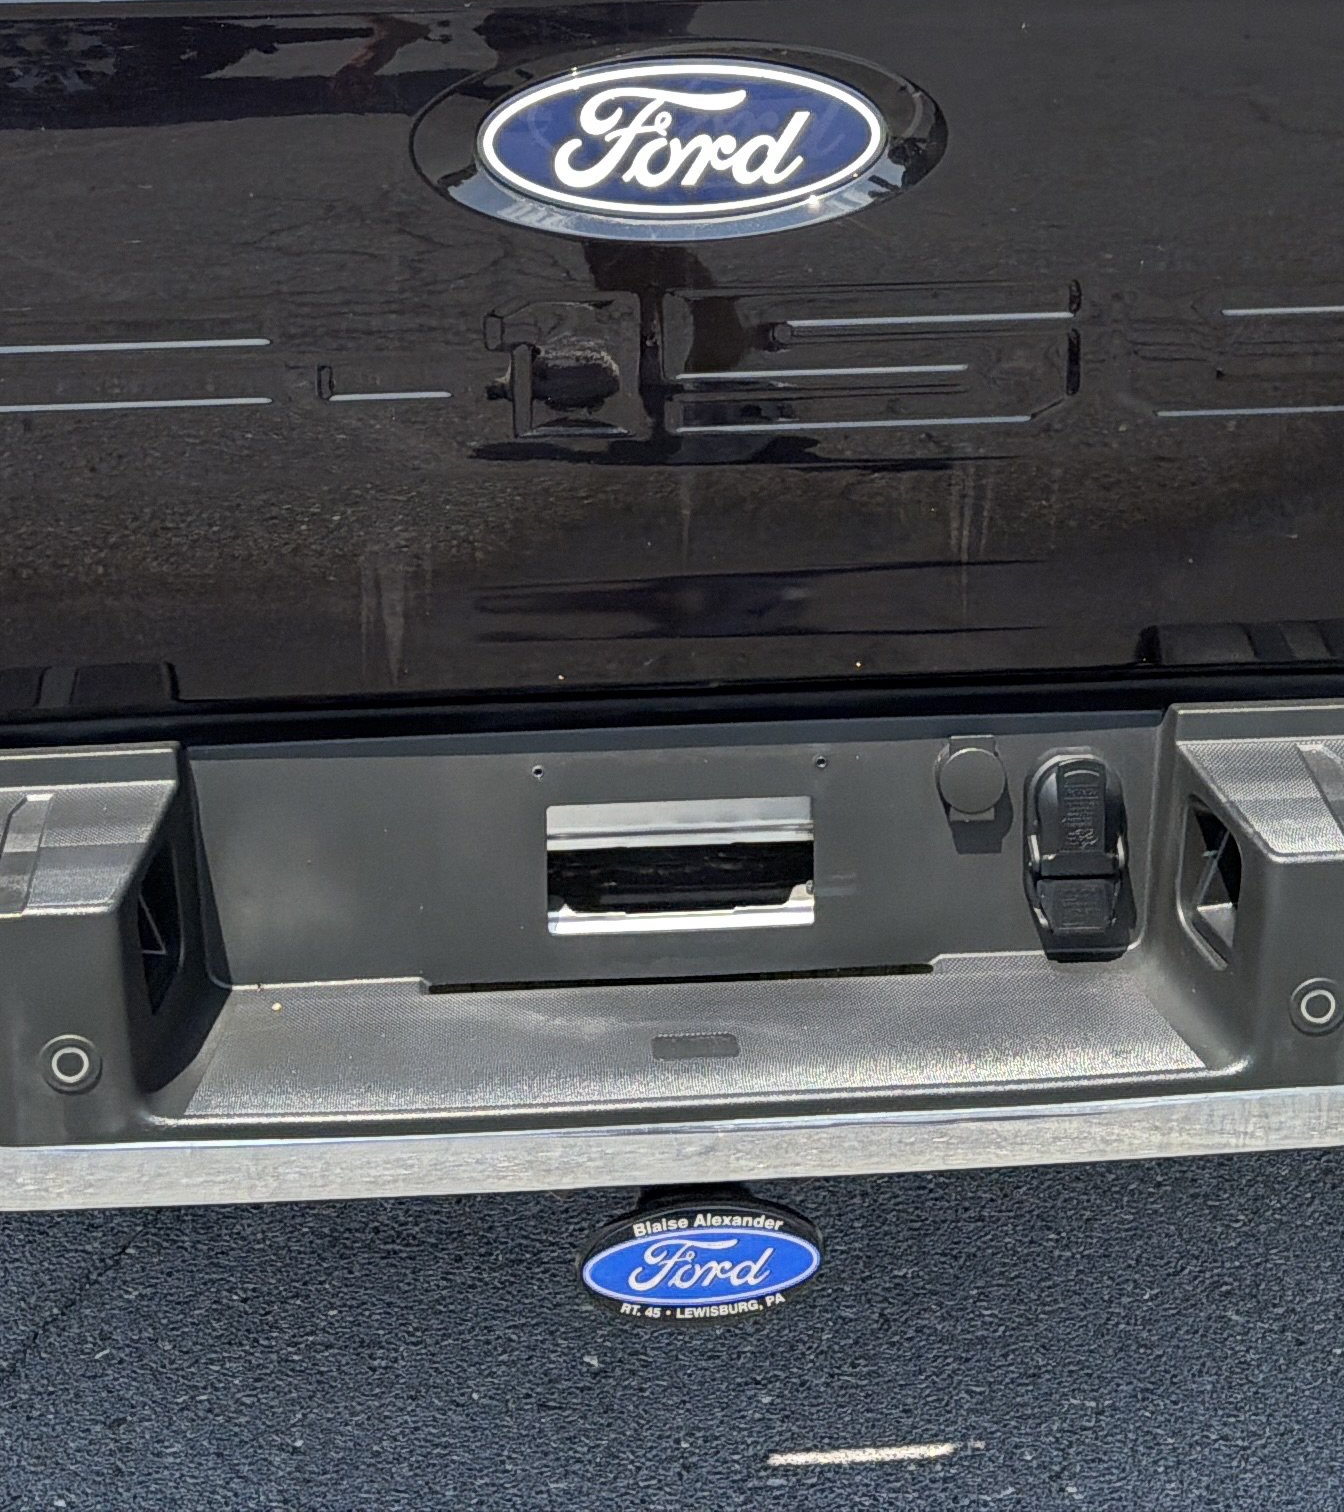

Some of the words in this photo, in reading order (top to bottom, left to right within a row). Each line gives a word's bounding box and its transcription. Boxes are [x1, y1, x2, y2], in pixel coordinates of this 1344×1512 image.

[555, 88, 810, 188] Ford
[633, 1218, 689, 1238] Blaise
[693, 1213, 784, 1231] Alexander
[628, 1238, 774, 1292] Ford
[620, 1302, 641, 1317] RT.
[644, 1307, 661, 1318] 45
[675, 1300, 764, 1319] LEWISBURG,
[766, 1292, 786, 1308] PA
